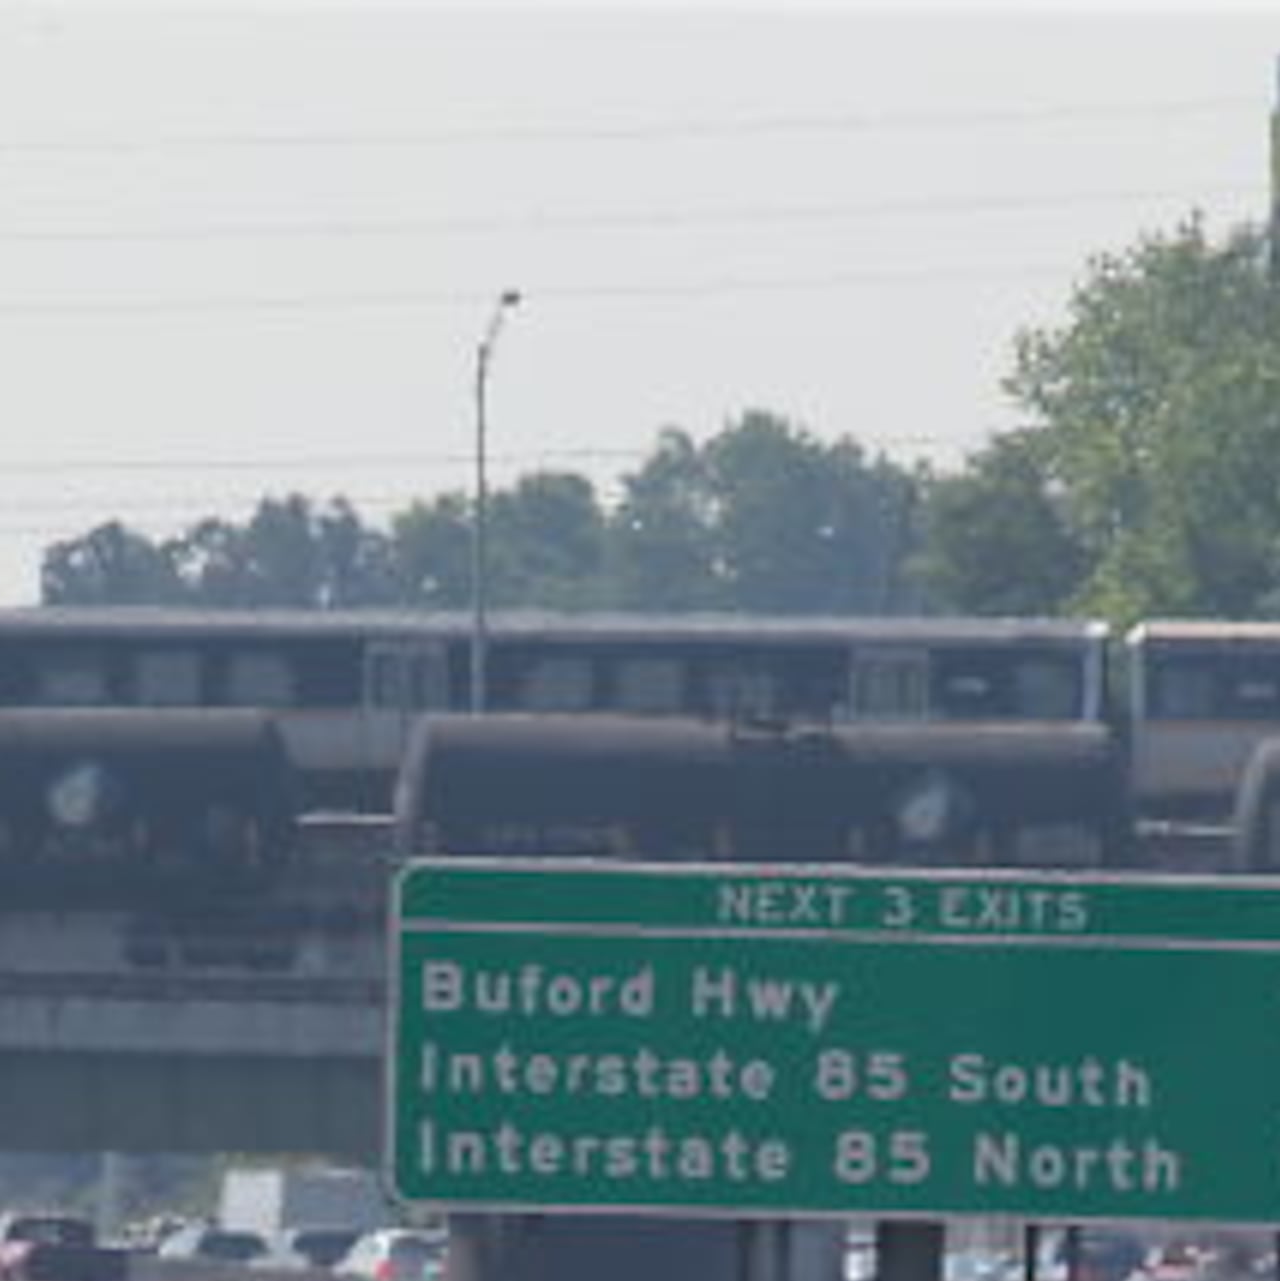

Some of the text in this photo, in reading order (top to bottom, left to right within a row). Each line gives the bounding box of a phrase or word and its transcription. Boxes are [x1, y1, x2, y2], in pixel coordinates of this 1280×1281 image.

[719, 884, 1089, 931] NEXT 3 EXITS
[422, 961, 655, 1017] Buford
[692, 966, 838, 1031] Hwy
[421, 1042, 774, 1101] Interstate
[815, 1048, 908, 1101] 85
[948, 1052, 1152, 1107] South
[421, 1119, 790, 1181] Interstate
[833, 1130, 930, 1186] 85
[973, 1132, 1182, 1193] North
